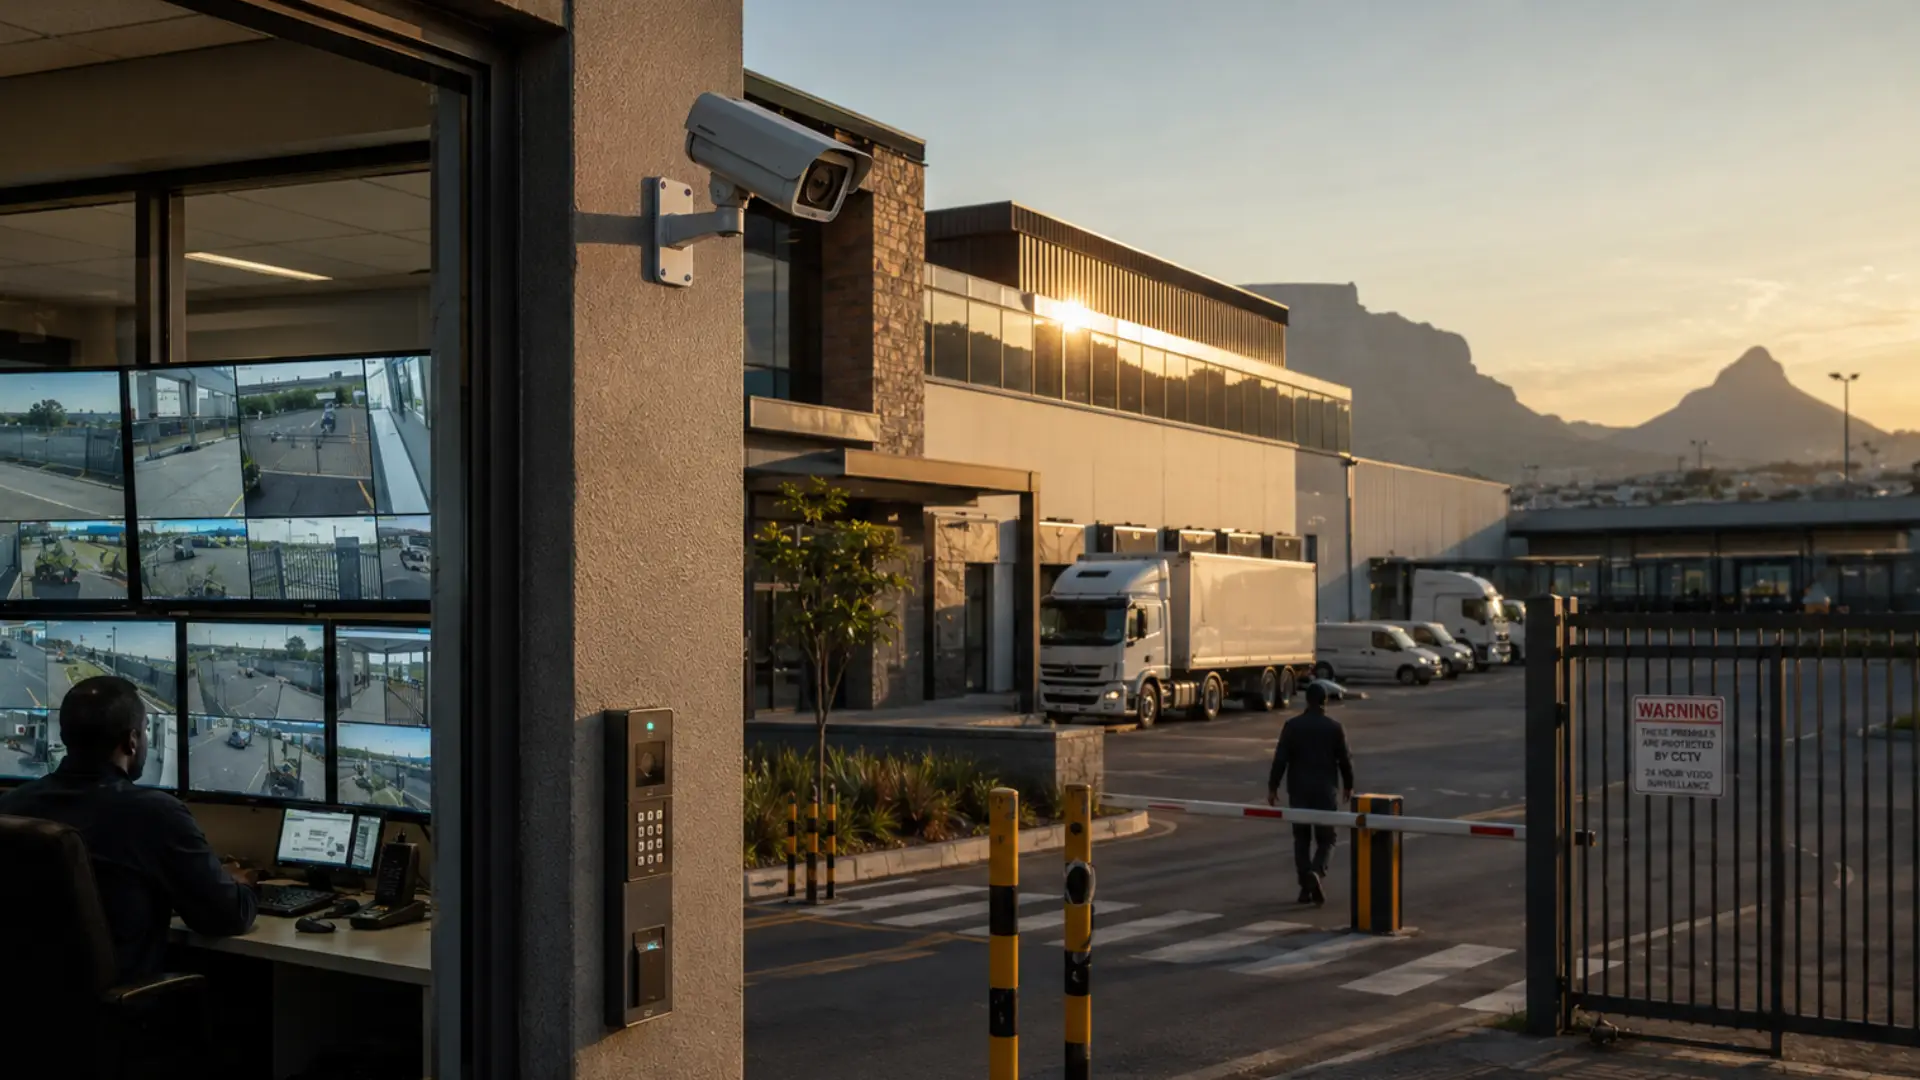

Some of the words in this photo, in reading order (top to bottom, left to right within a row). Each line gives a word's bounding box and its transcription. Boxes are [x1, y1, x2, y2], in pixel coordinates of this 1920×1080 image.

[1638, 702, 1719, 720] WARNING
[1654, 751, 1669, 761] BY
[1671, 751, 1702, 762] CCTV
